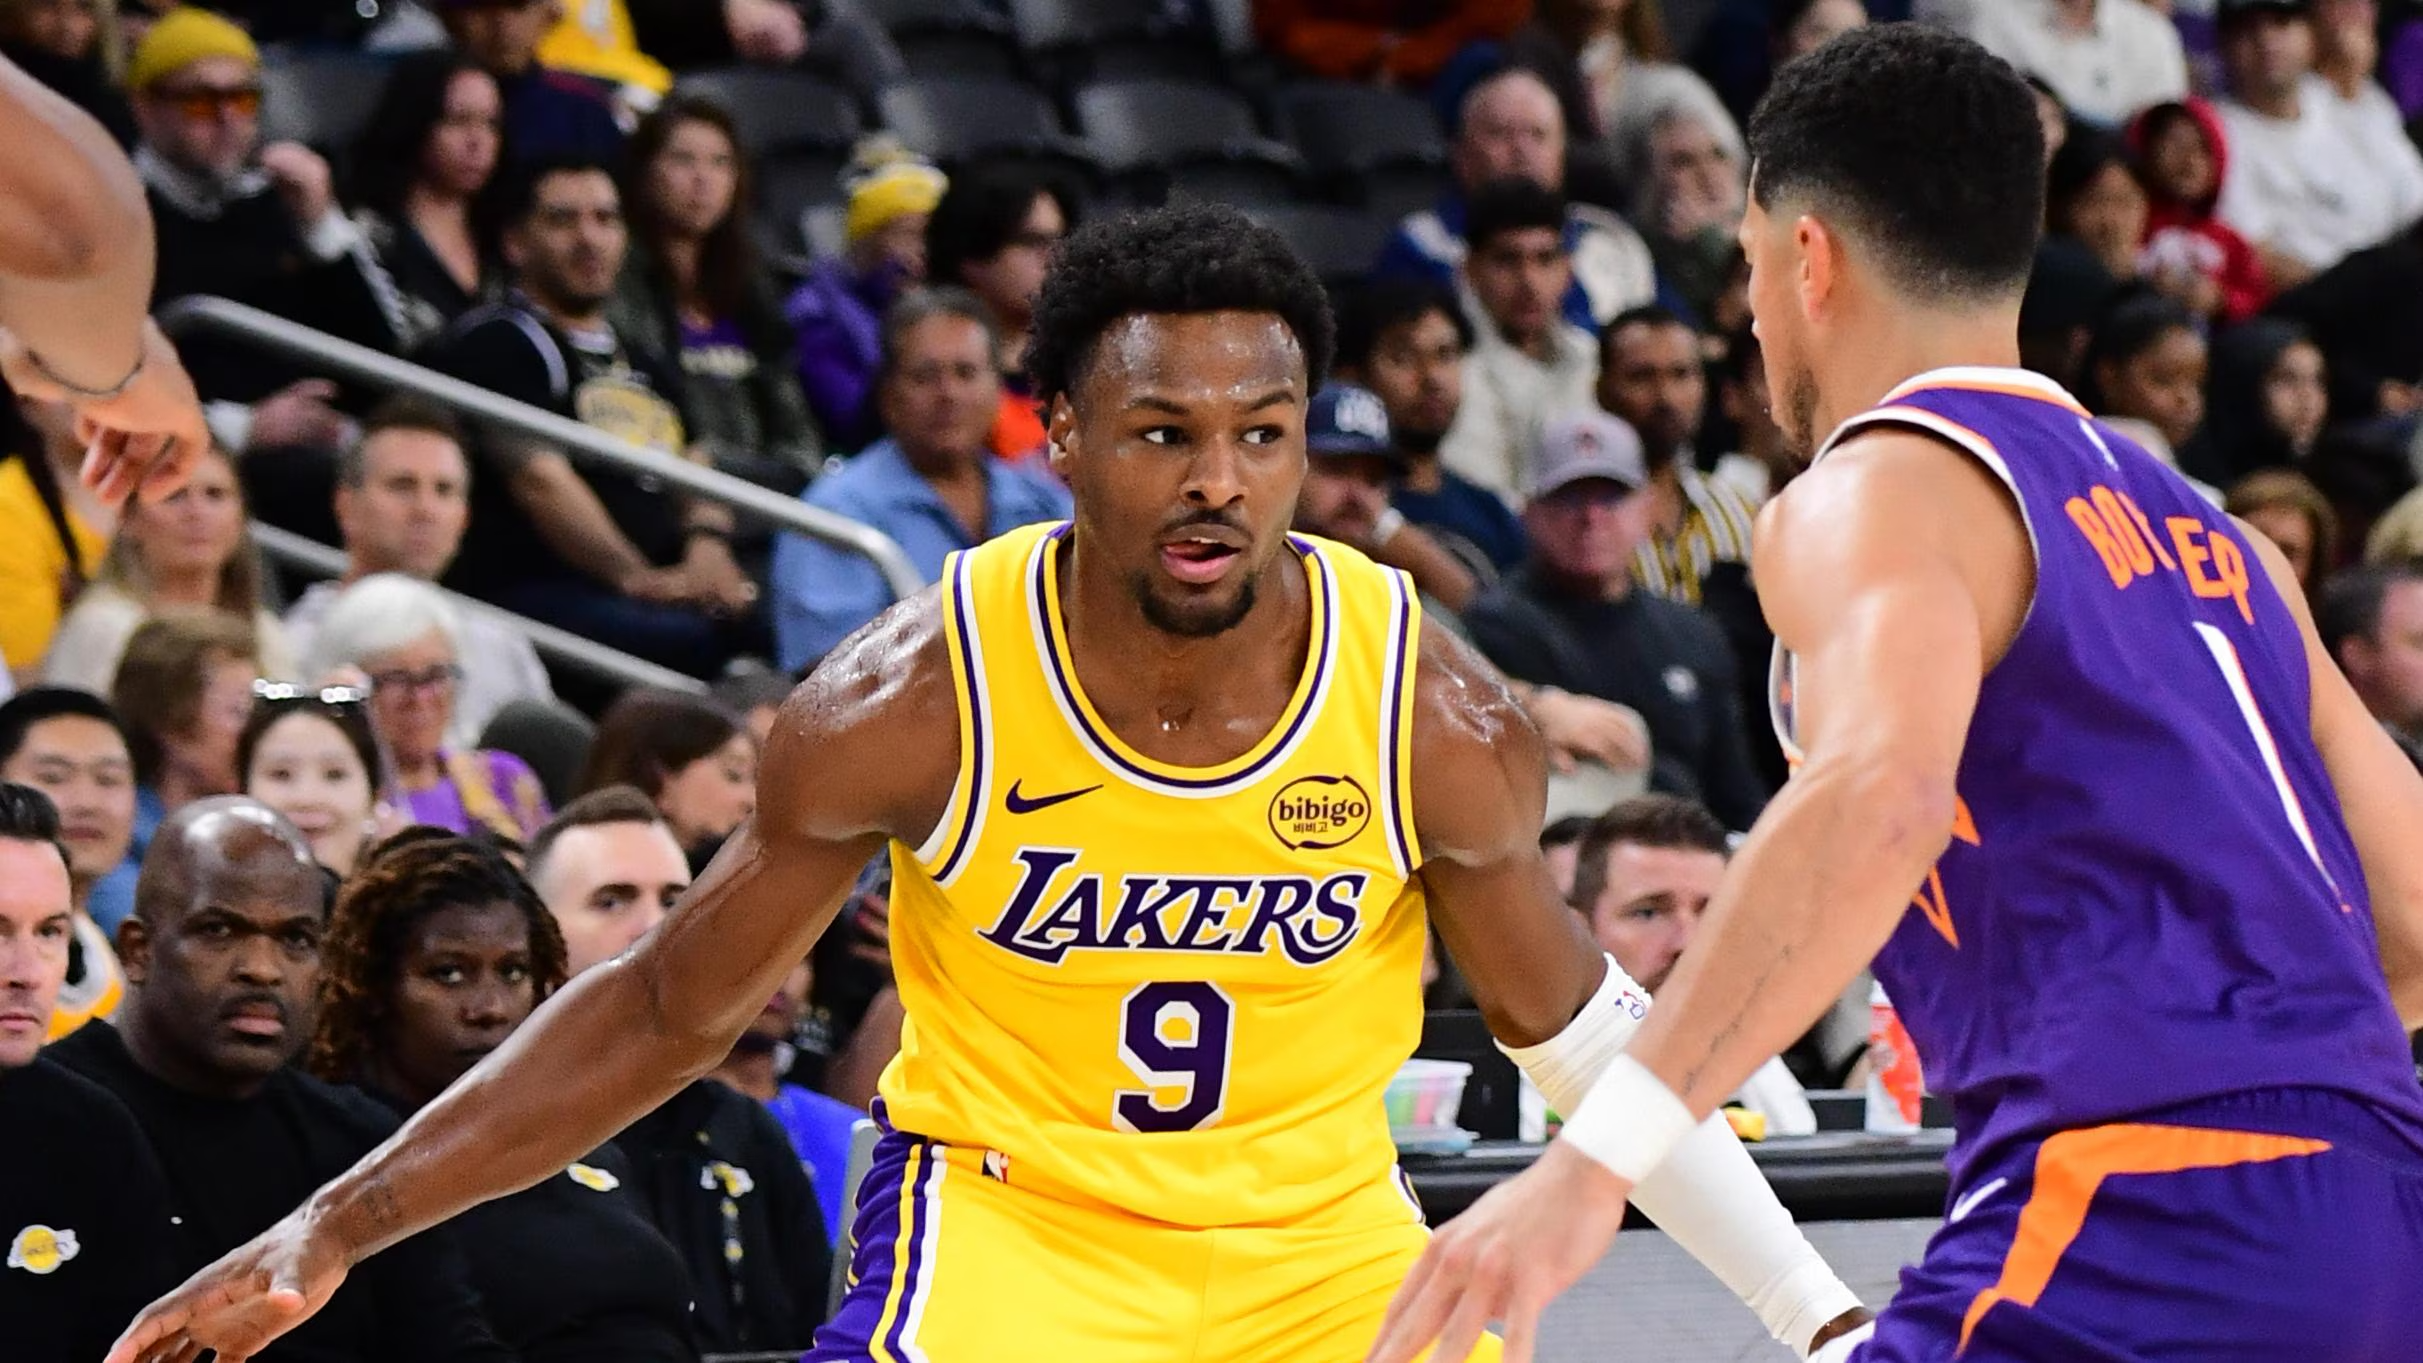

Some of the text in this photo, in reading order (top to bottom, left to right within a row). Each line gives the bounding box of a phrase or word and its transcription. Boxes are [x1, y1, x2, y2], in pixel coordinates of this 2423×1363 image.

[1280, 795, 1364, 827] bibigo
[2192, 620, 2353, 912] 1
[1293, 822, 1328, 833] 비비고
[977, 847, 1370, 966] LAKERS
[1112, 980, 1235, 1132] 9
